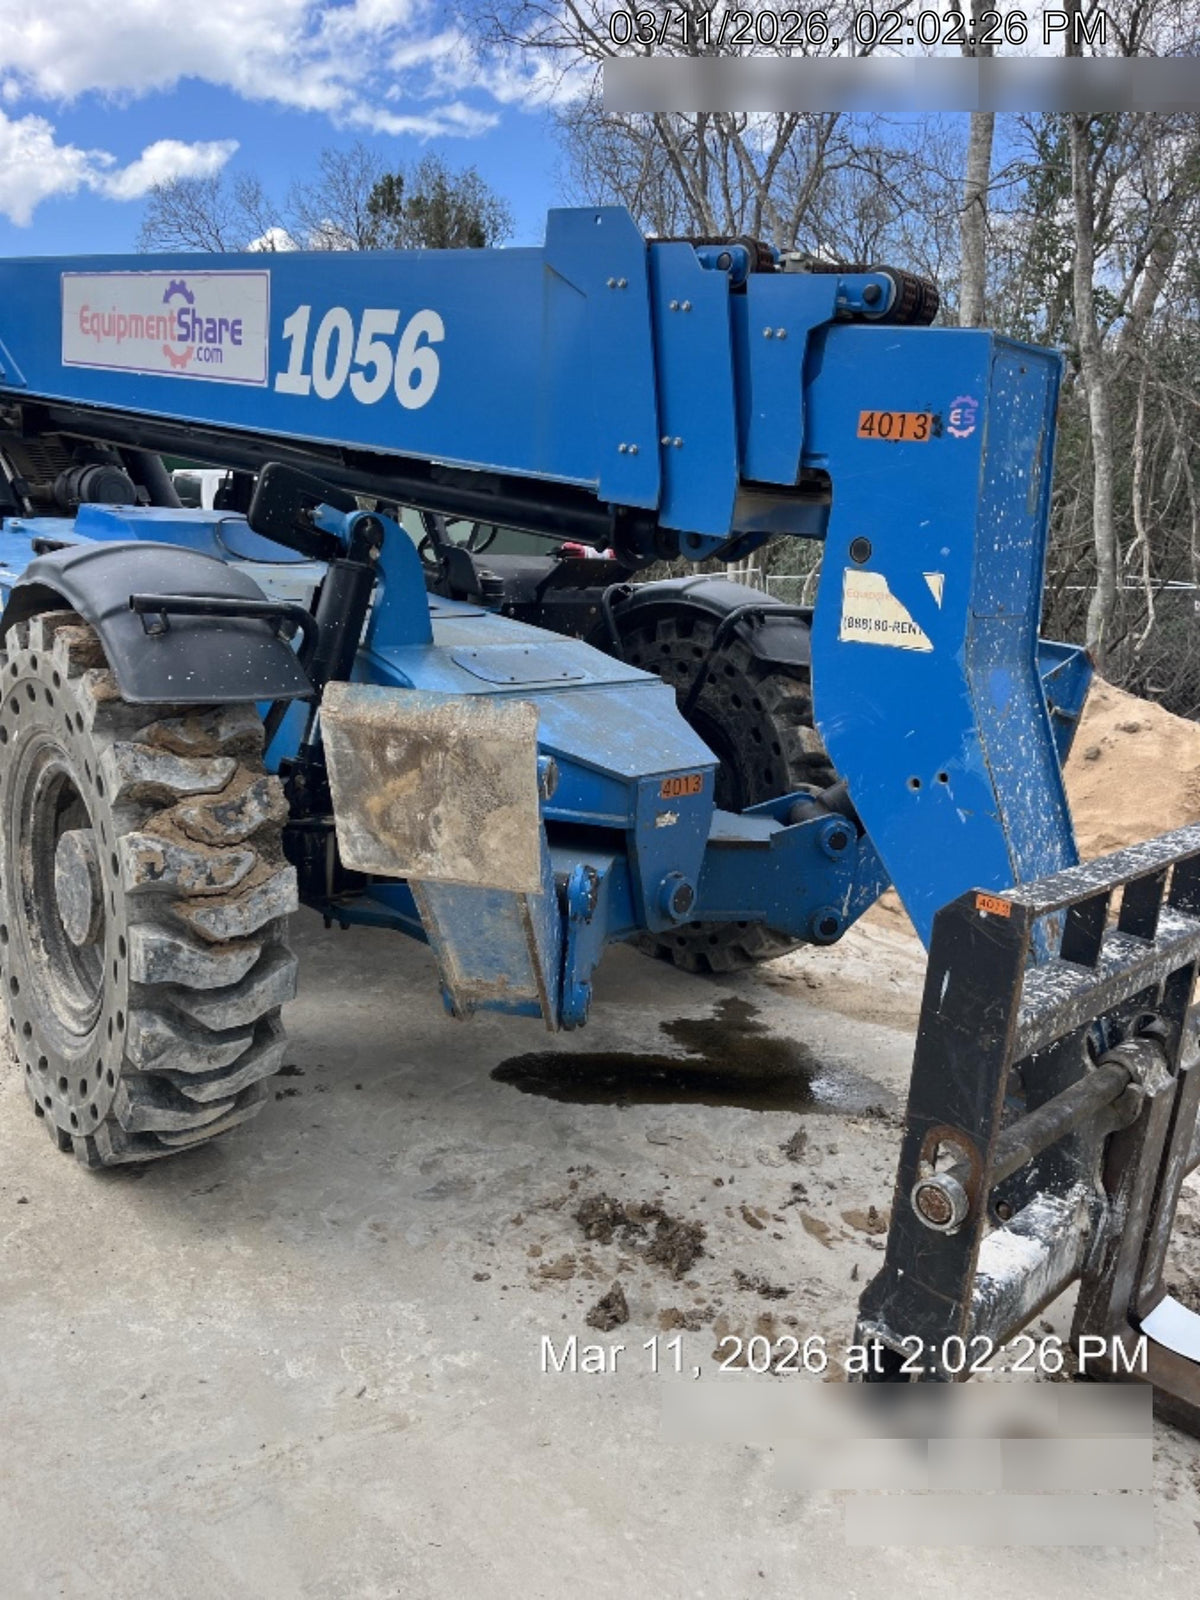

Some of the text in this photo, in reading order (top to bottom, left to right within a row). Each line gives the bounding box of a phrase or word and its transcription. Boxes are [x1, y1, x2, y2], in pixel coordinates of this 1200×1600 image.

[79, 304, 243, 346] EquipmentShare
[193, 346, 223, 364] .com
[274, 305, 446, 410] 1056
[860, 412, 928, 440] 4013
[662, 774, 701, 797] 4013
